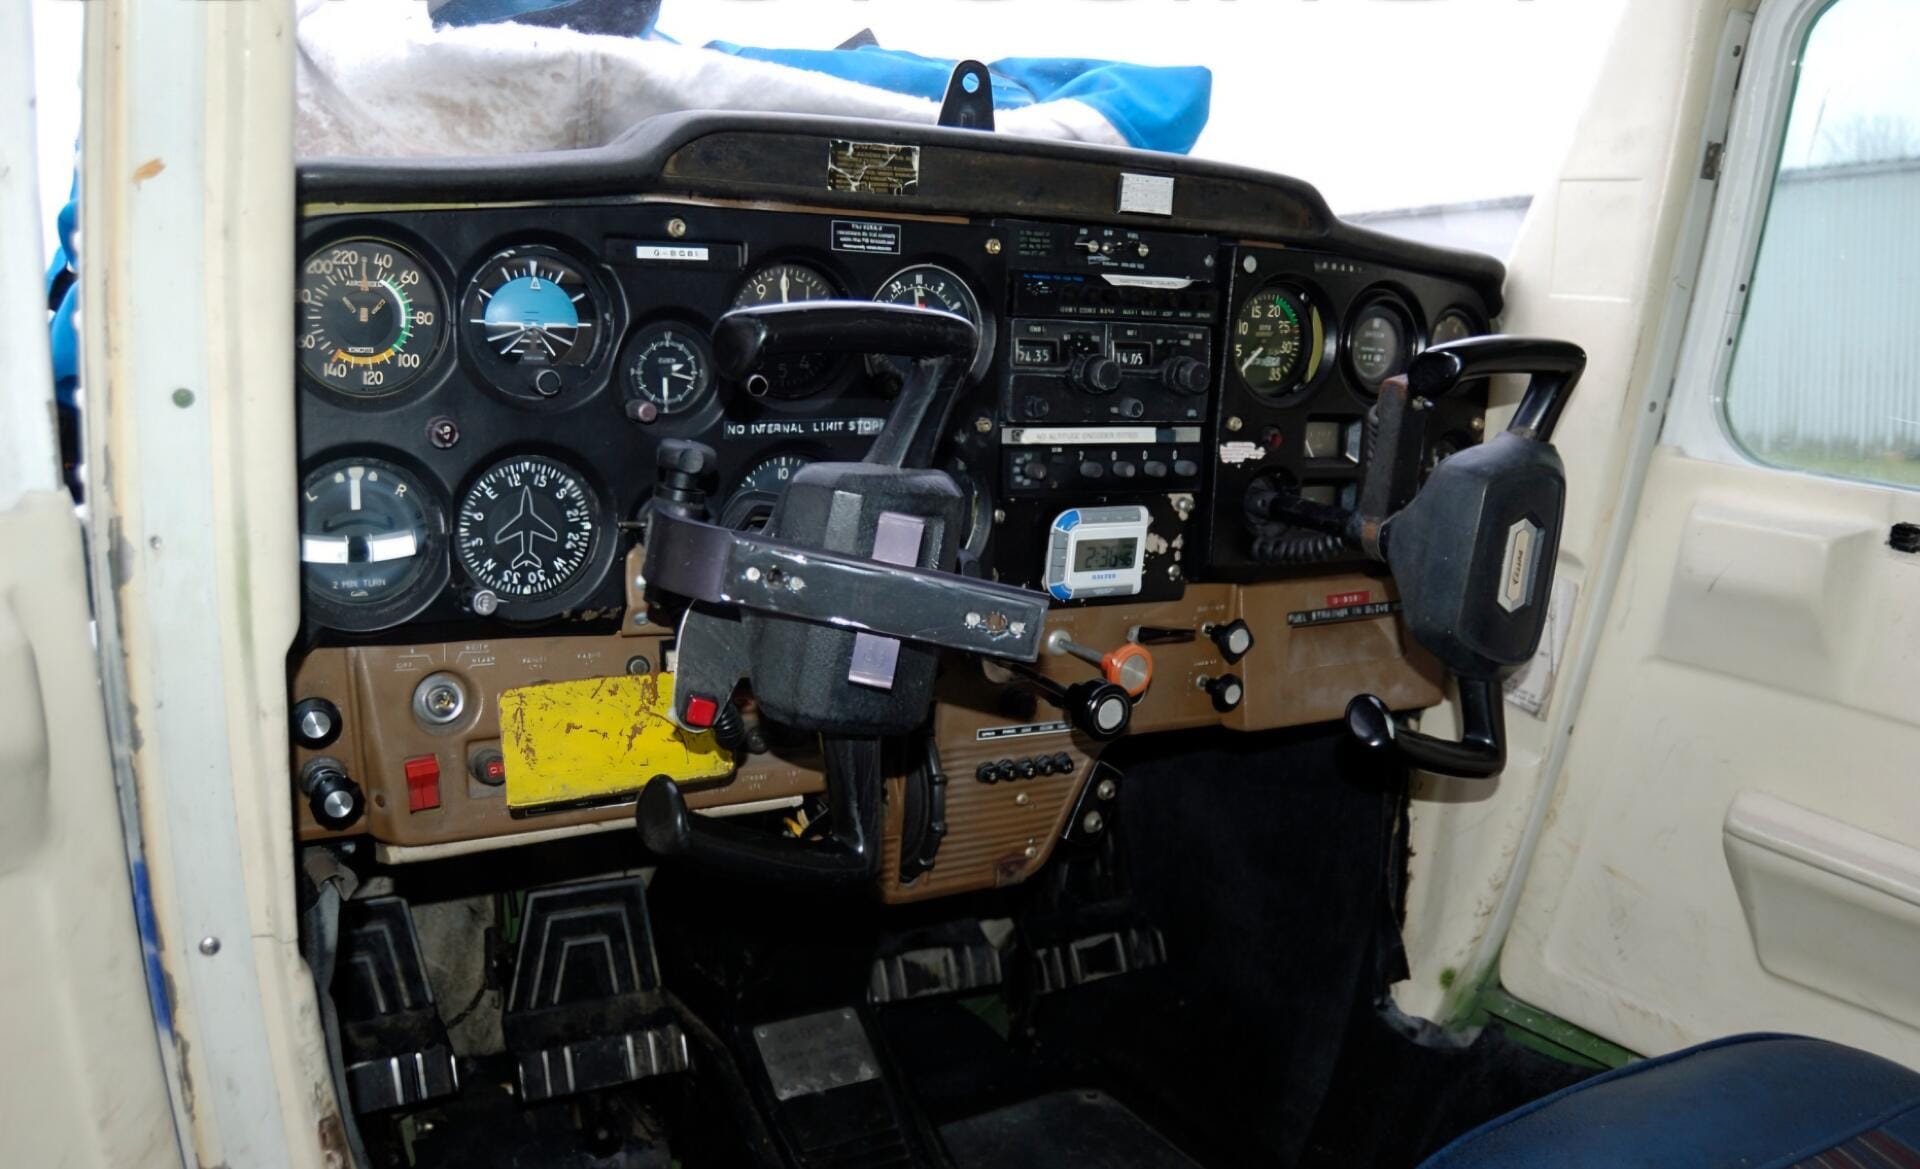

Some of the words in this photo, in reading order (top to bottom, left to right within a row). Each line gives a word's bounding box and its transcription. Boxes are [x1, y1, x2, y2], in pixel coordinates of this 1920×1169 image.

[332, 250, 358, 265] 220
[374, 253, 393, 268] 40
[306, 259, 334, 274] 200
[401, 271, 420, 285] 60
[756, 284, 767, 300] 9
[1251, 306, 1262, 319] 15
[1267, 303, 1281, 318] 20
[416, 312, 434, 325] 80
[1238, 320, 1248, 335] 10
[1278, 321, 1291, 334] 25
[1235, 344, 1242, 357] 5
[398, 354, 419, 368] 100
[324, 363, 347, 377] 140
[363, 371, 383, 385] 120
[727, 424, 745, 435] NO
[751, 422, 805, 434] INTERNAL
[813, 421, 843, 433] LIMIT
[508, 473, 522, 487] 12
[534, 474, 547, 487] 15
[777, 467, 789, 480] 10
[305, 491, 319, 502] L
[395, 484, 408, 497] R
[485, 487, 499, 500] E
[556, 488, 568, 500] S
[566, 509, 580, 522] 21
[565, 533, 580, 550] 24
[483, 558, 497, 572] N
[553, 557, 568, 571] W
[528, 569, 546, 584] 30
